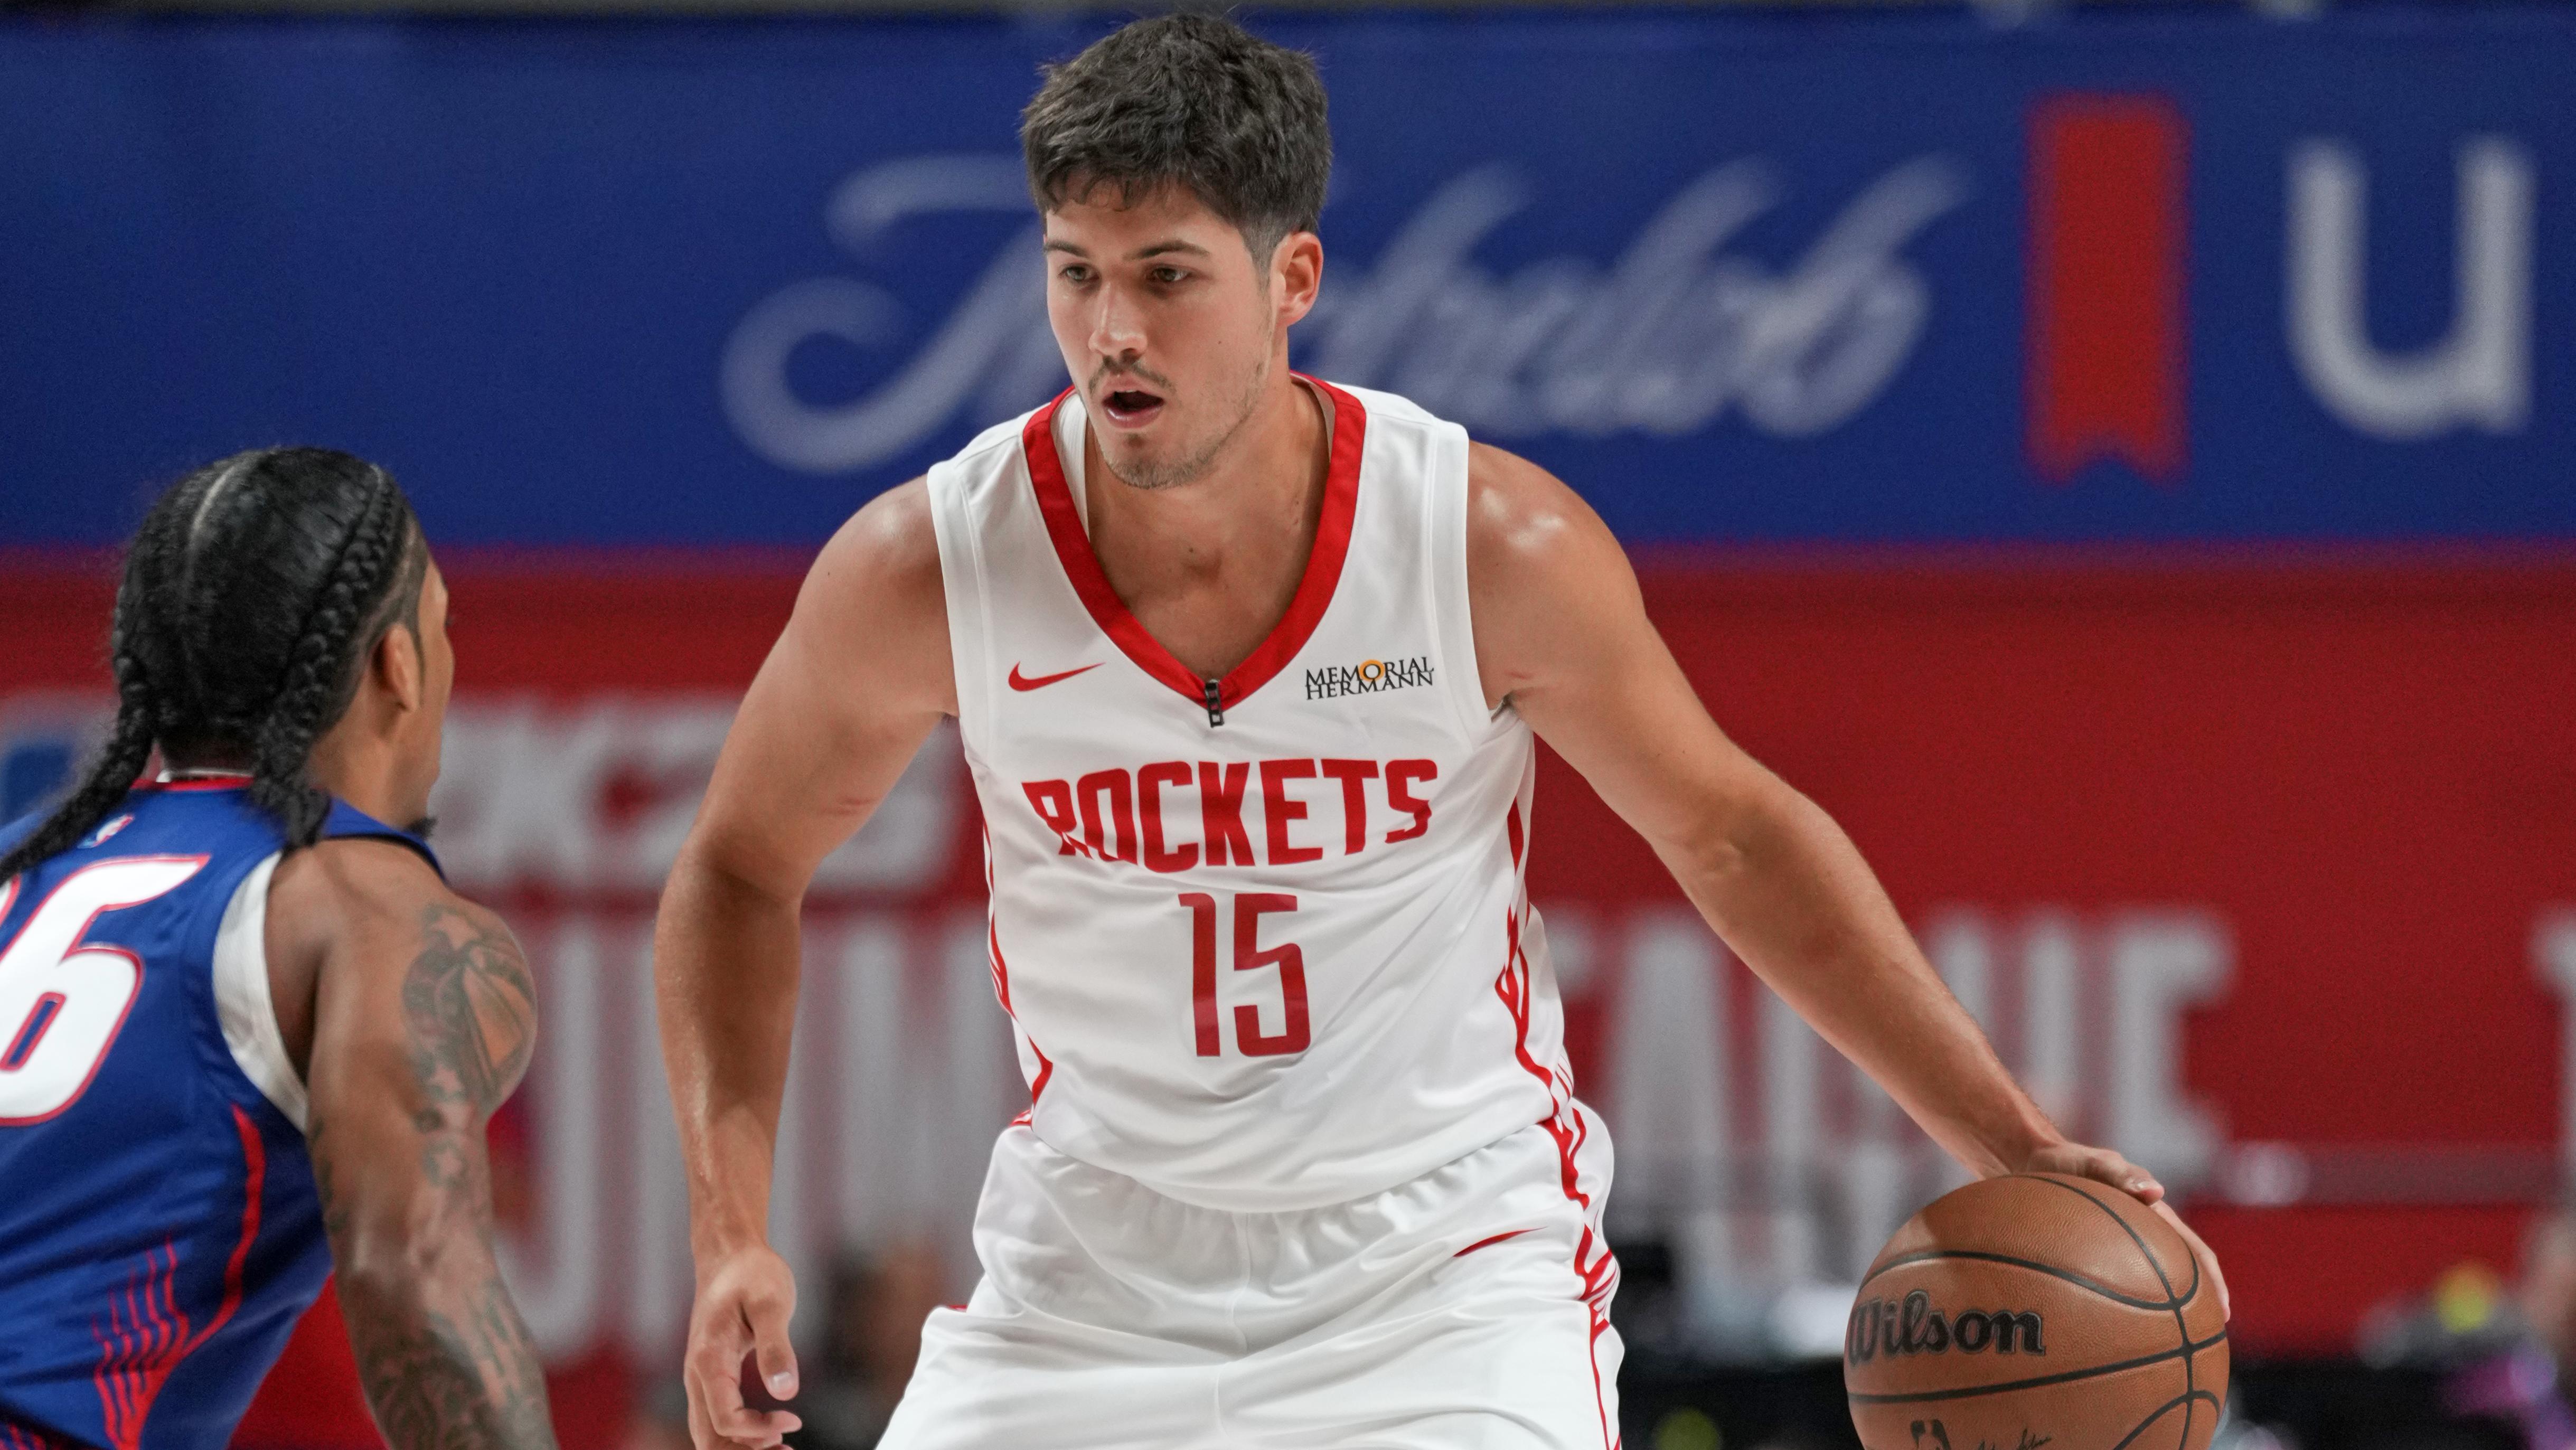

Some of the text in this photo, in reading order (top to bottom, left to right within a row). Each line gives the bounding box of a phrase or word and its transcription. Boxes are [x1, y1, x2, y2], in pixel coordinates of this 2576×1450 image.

[1305, 656, 1434, 685] MEMORIAL
[1305, 671, 1433, 700] HERMANN
[1021, 758, 1438, 873] ROCKETS
[1178, 892, 1311, 1057] 15
[1849, 1288, 2046, 1368] Wilson
